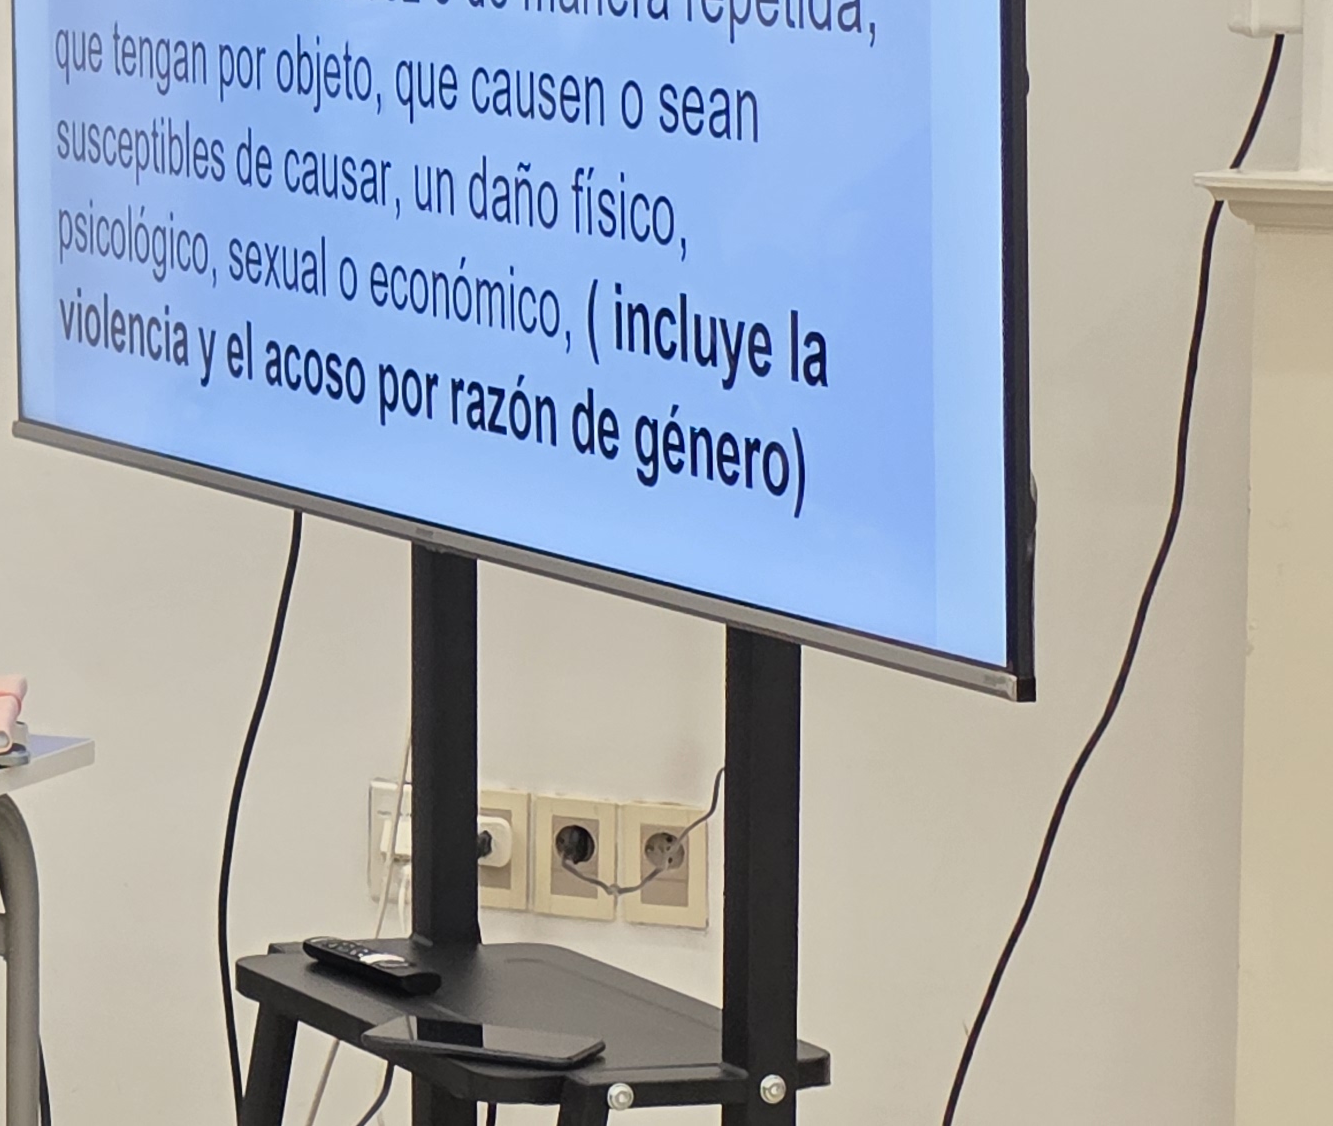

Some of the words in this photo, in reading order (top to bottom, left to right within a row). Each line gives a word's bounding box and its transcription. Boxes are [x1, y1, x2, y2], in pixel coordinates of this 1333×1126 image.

[55, 29, 103, 86] que
[112, 21, 207, 96] tengan
[218, 43, 267, 104] por
[276, 33, 382, 116] objeto,
[395, 59, 459, 125] que
[471, 66, 605, 127] causen
[620, 79, 644, 131] o
[658, 82, 759, 144] sean
[57, 116, 226, 186] susceptibles
[235, 126, 273, 189] de
[283, 148, 401, 221] causar,
[414, 164, 455, 217] un
[468, 154, 559, 230] daño
[570, 166, 687, 263] físico,
[58, 198, 217, 289] psicológico,
[228, 235, 327, 298] sexual
[339, 256, 358, 302] o
[369, 255, 571, 355] económico,
[587, 278, 600, 366] (
[614, 281, 773, 391] incluye
[790, 309, 829, 388] la
[58, 286, 190, 367] violencia
[197, 326, 217, 388] y
[226, 319, 254, 381] el
[264, 339, 366, 406] acoso
[378, 362, 440, 427] por
[450, 373, 558, 448] razón
[571, 386, 620, 461] de
[634, 403, 806, 520] género)
